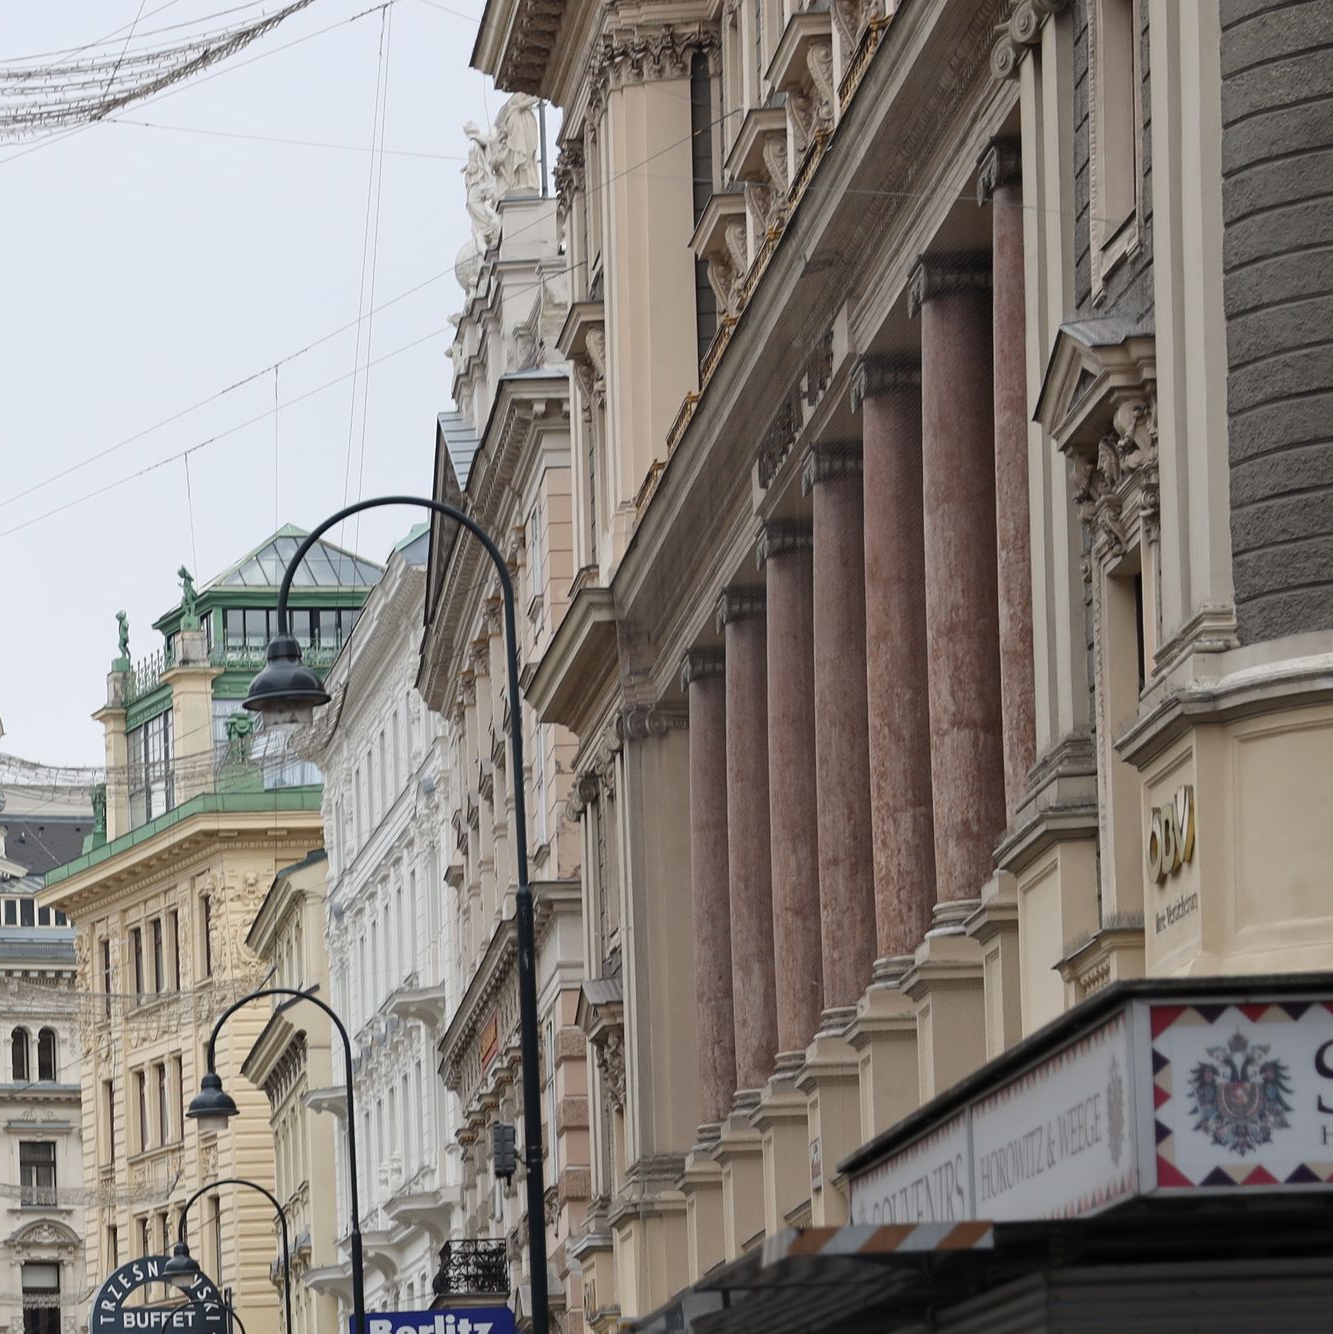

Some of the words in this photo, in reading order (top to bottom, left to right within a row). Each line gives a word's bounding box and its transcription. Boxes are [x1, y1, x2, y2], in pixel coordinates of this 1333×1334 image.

[980, 1126, 1044, 1201] HOROWITZ
[1057, 1092, 1103, 1161] WEEGE
[100, 1260, 221, 1325] TRZEŚNSKI
[123, 1311, 196, 1328] BUFFET
